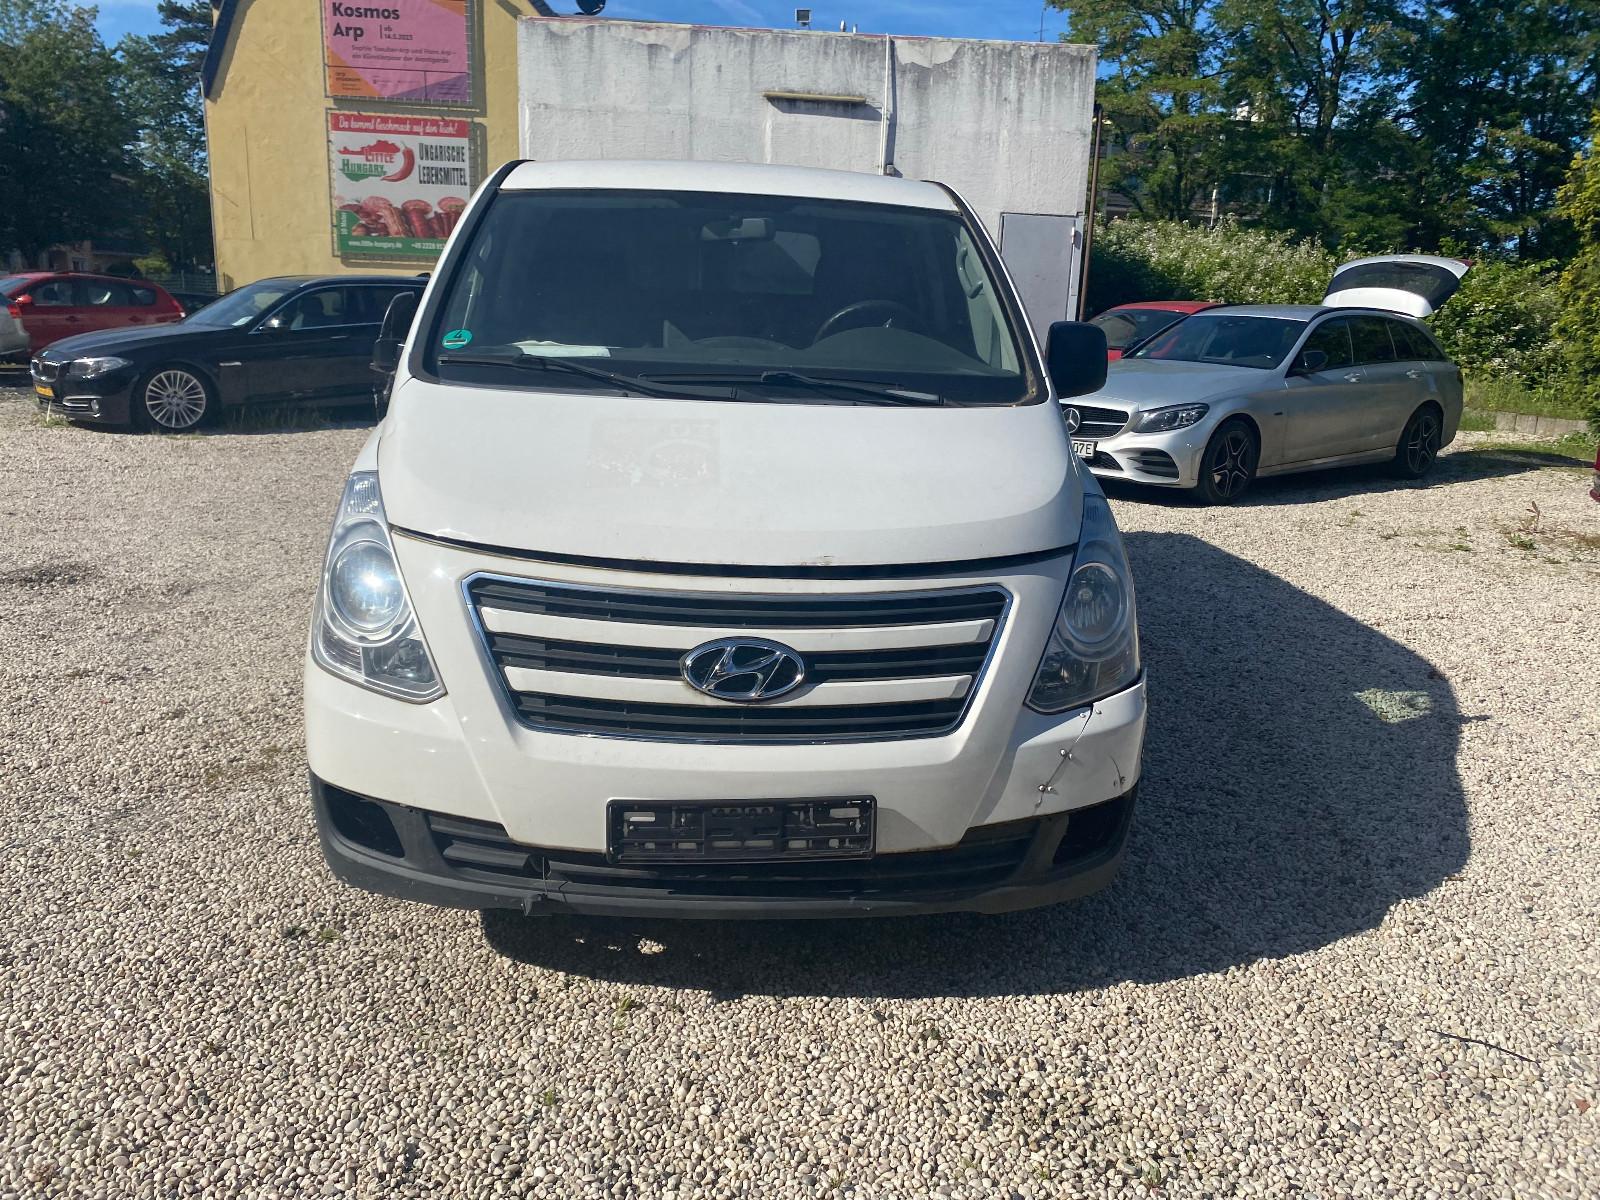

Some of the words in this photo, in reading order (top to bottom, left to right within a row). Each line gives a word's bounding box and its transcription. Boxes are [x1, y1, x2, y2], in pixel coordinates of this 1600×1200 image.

[332, 2, 400, 20] Kosmos
[333, 22, 364, 41] Arp
[339, 115, 348, 129] Da
[350, 116, 375, 130] kommt
[375, 118, 412, 132] Geschmack
[412, 120, 424, 136] auf
[425, 121, 437, 133] den
[438, 121, 458, 134] Tisch!
[454, 330, 462, 338] 4
